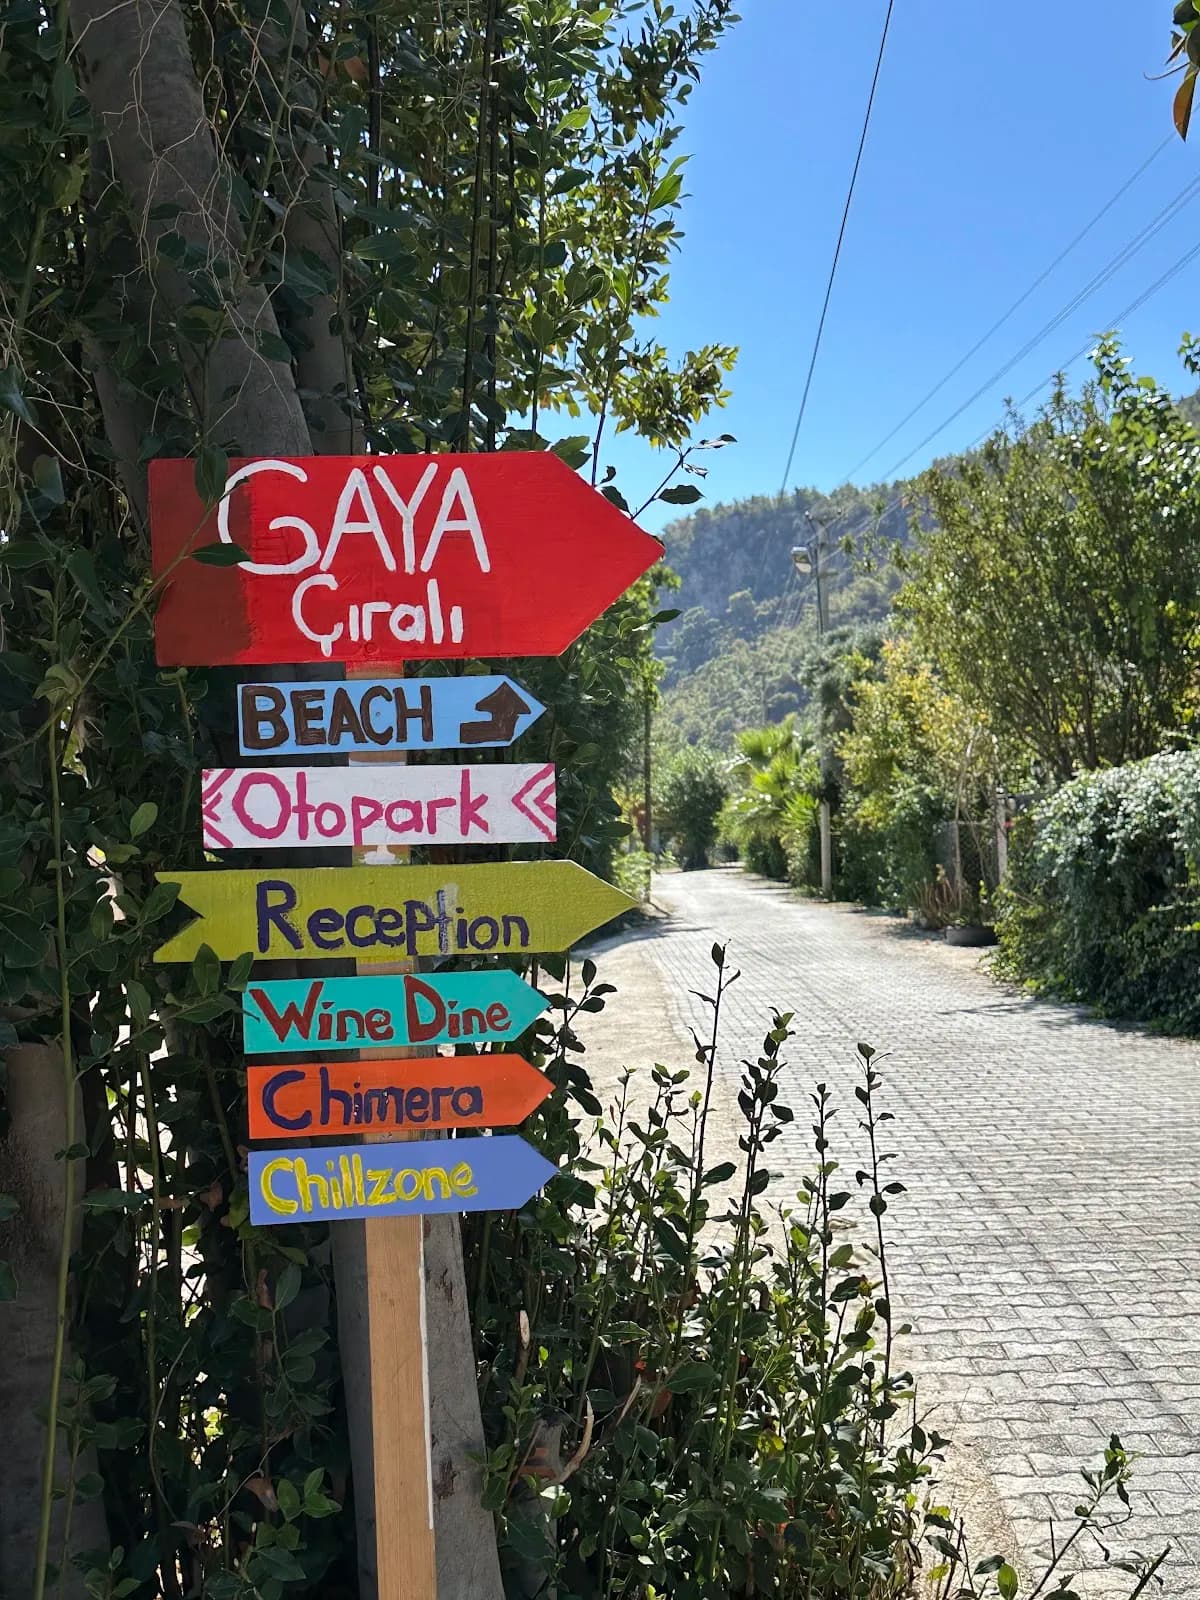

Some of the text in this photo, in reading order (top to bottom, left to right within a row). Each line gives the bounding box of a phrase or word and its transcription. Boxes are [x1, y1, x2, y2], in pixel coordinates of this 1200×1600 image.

[217, 459, 492, 576] GAYA
[291, 573, 464, 657] Çıralı
[241, 685, 434, 750] BEACH
[231, 768, 490, 846] Otopark
[255, 879, 531, 957] Reception
[248, 974, 513, 1043] Wine Dine
[262, 1066, 484, 1131] Chimera
[260, 1153, 479, 1216] Chillzone
